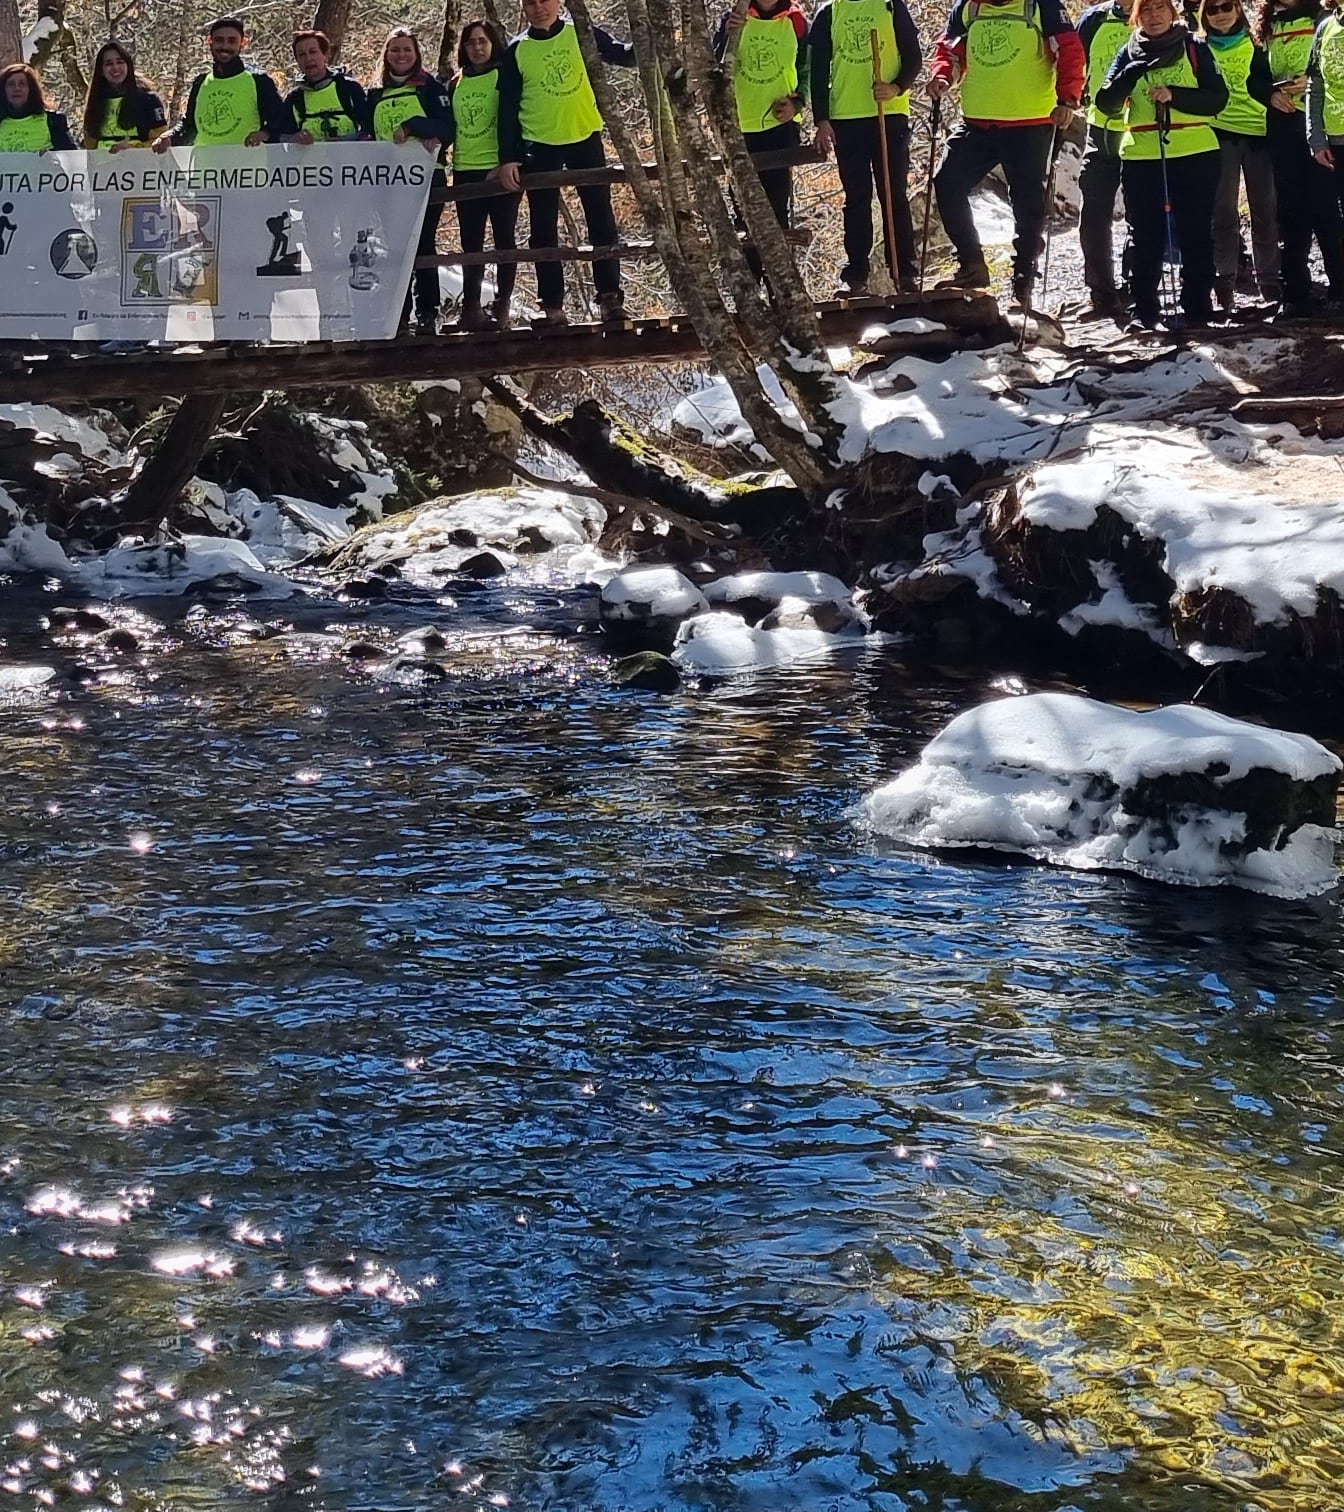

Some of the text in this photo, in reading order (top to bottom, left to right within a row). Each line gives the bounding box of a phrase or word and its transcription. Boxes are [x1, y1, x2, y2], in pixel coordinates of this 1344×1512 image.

[38, 173, 85, 193] POR
[92, 171, 135, 192] LAS
[142, 165, 333, 191] ENFERMEDADES
[341, 165, 425, 187] RARAS
